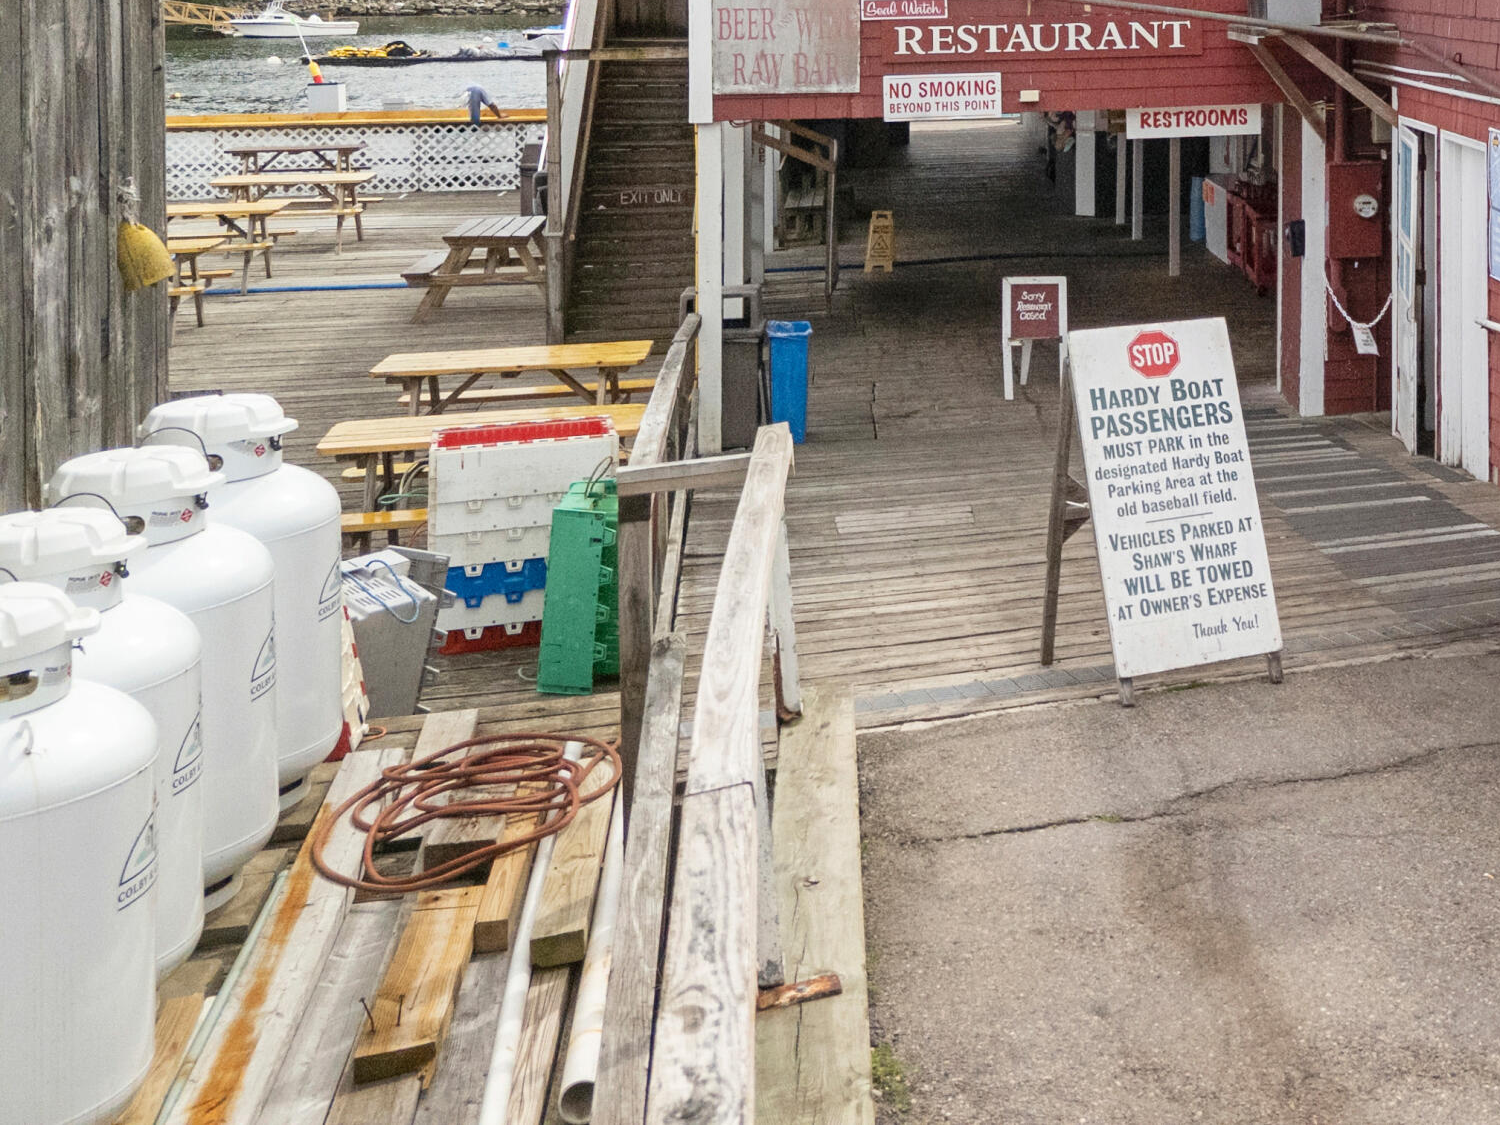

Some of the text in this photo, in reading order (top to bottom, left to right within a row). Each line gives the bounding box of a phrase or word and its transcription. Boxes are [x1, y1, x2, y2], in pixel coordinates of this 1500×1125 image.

[866, 1, 942, 16] Seal Watch
[717, 8, 776, 41] BEER
[894, 20, 1191, 56] RESTAURANT
[732, 51, 841, 88] RAW BAR
[889, 80, 997, 99] NO SMOKING
[889, 100, 996, 114] BEYOND THIS POINT
[1139, 108, 1248, 129] RESTROOMS
[620, 189, 681, 205] EXIT ONLY
[1021, 291, 1046, 303] Sorry
[1132, 342, 1175, 367] STOP
[1089, 378, 1223, 411] HARDY BOAT
[1090, 401, 1233, 440] PASSENGERS
[1103, 432, 1230, 460] MUST PARK in the
[1095, 449, 1245, 481] designated Hardy Boat
[1108, 469, 1238, 499] Parking Area at the
[1116, 488, 1237, 518] old baseball field.
[1109, 517, 1252, 552] VEHICLES PARKED AT
[1190, 541, 1238, 562] WHARF
[1124, 559, 1253, 596] WILL BE TOWED
[1118, 605, 1133, 621] AT
[1207, 583, 1268, 606] EXPENSE
[1192, 614, 1259, 639] Thank You!
[117, 877, 147, 903] COLBY
